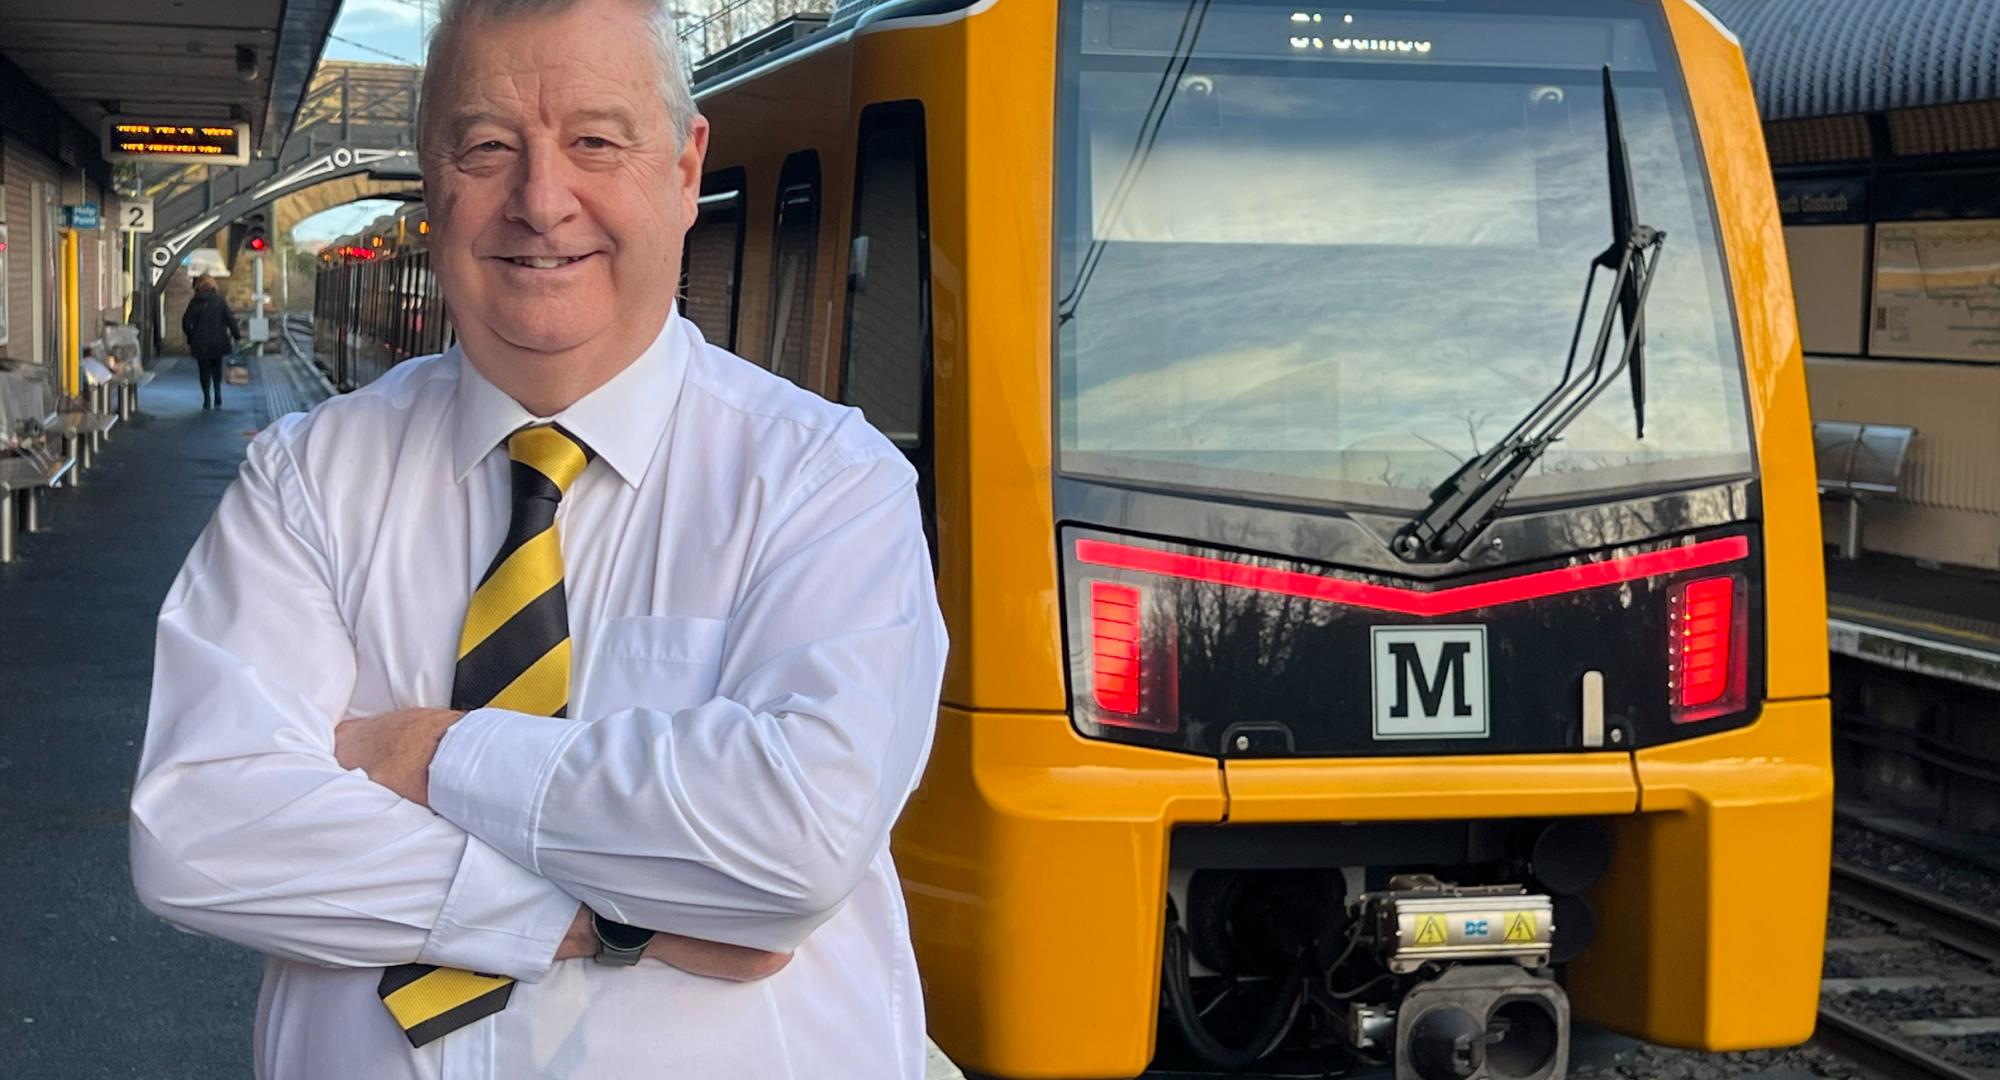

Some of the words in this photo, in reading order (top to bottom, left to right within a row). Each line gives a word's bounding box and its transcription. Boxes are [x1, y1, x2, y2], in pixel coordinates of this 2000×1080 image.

[128, 207, 144, 227] 2
[1388, 641, 1472, 718] M
[1464, 920, 1488, 936] DC
